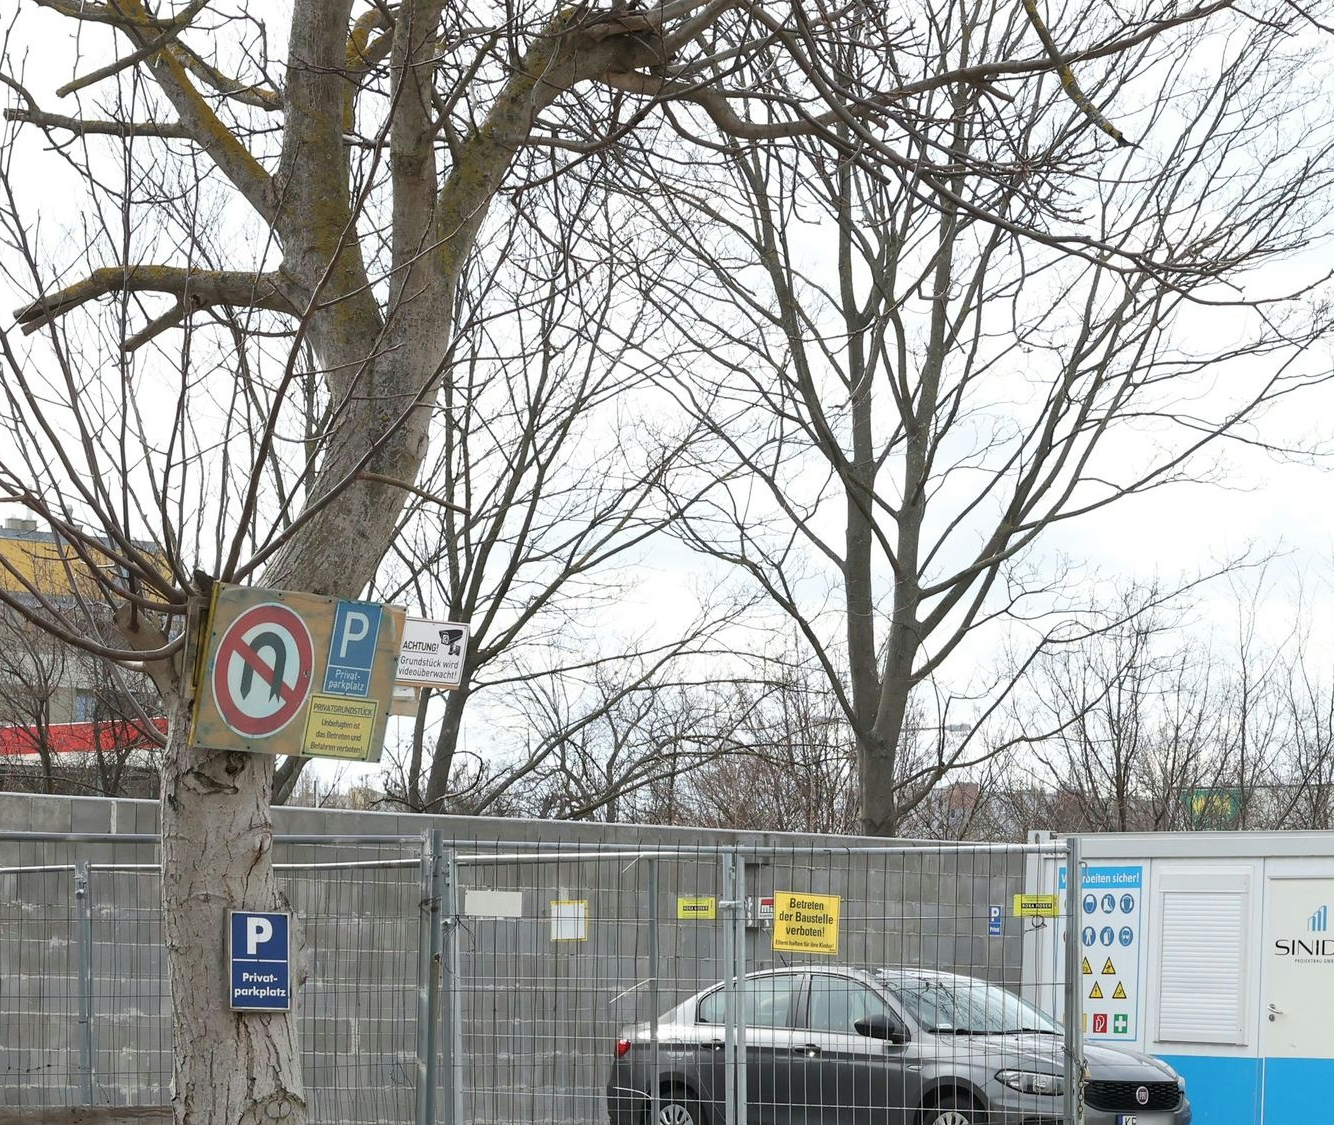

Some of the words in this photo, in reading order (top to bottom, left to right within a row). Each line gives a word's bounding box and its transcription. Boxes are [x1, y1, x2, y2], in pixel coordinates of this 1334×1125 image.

[339, 611, 369, 658] P
[403, 640, 440, 652] ACHTUNG!
[400, 655, 442, 668] Grundstück
[443, 660, 459, 669] wird
[335, 669, 361, 680] Privat-
[398, 667, 457, 680] videoüberwacht!
[328, 680, 365, 692] parkplatz
[313, 702, 373, 716] PRIVATGRUNDSTÜCK
[321, 719, 353, 730] Unbefugten
[315, 730, 326, 739] das
[327, 731, 351, 740] Betreten
[351, 734, 363, 742] und
[310, 741, 336, 751] Befahren
[336, 745, 364, 753] verboten!
[1082, 872, 1111, 884] rbeiten
[1112, 872, 1140, 883] sicher!
[789, 897, 825, 911] Betreten
[779, 910, 794, 921] der
[795, 911, 834, 925] Baustelle
[247, 916, 273, 955] P
[786, 925, 825, 938] verboten!
[788, 940, 803, 948] haften
[242, 972, 278, 983] Privat-
[234, 985, 287, 999] parkplatz
